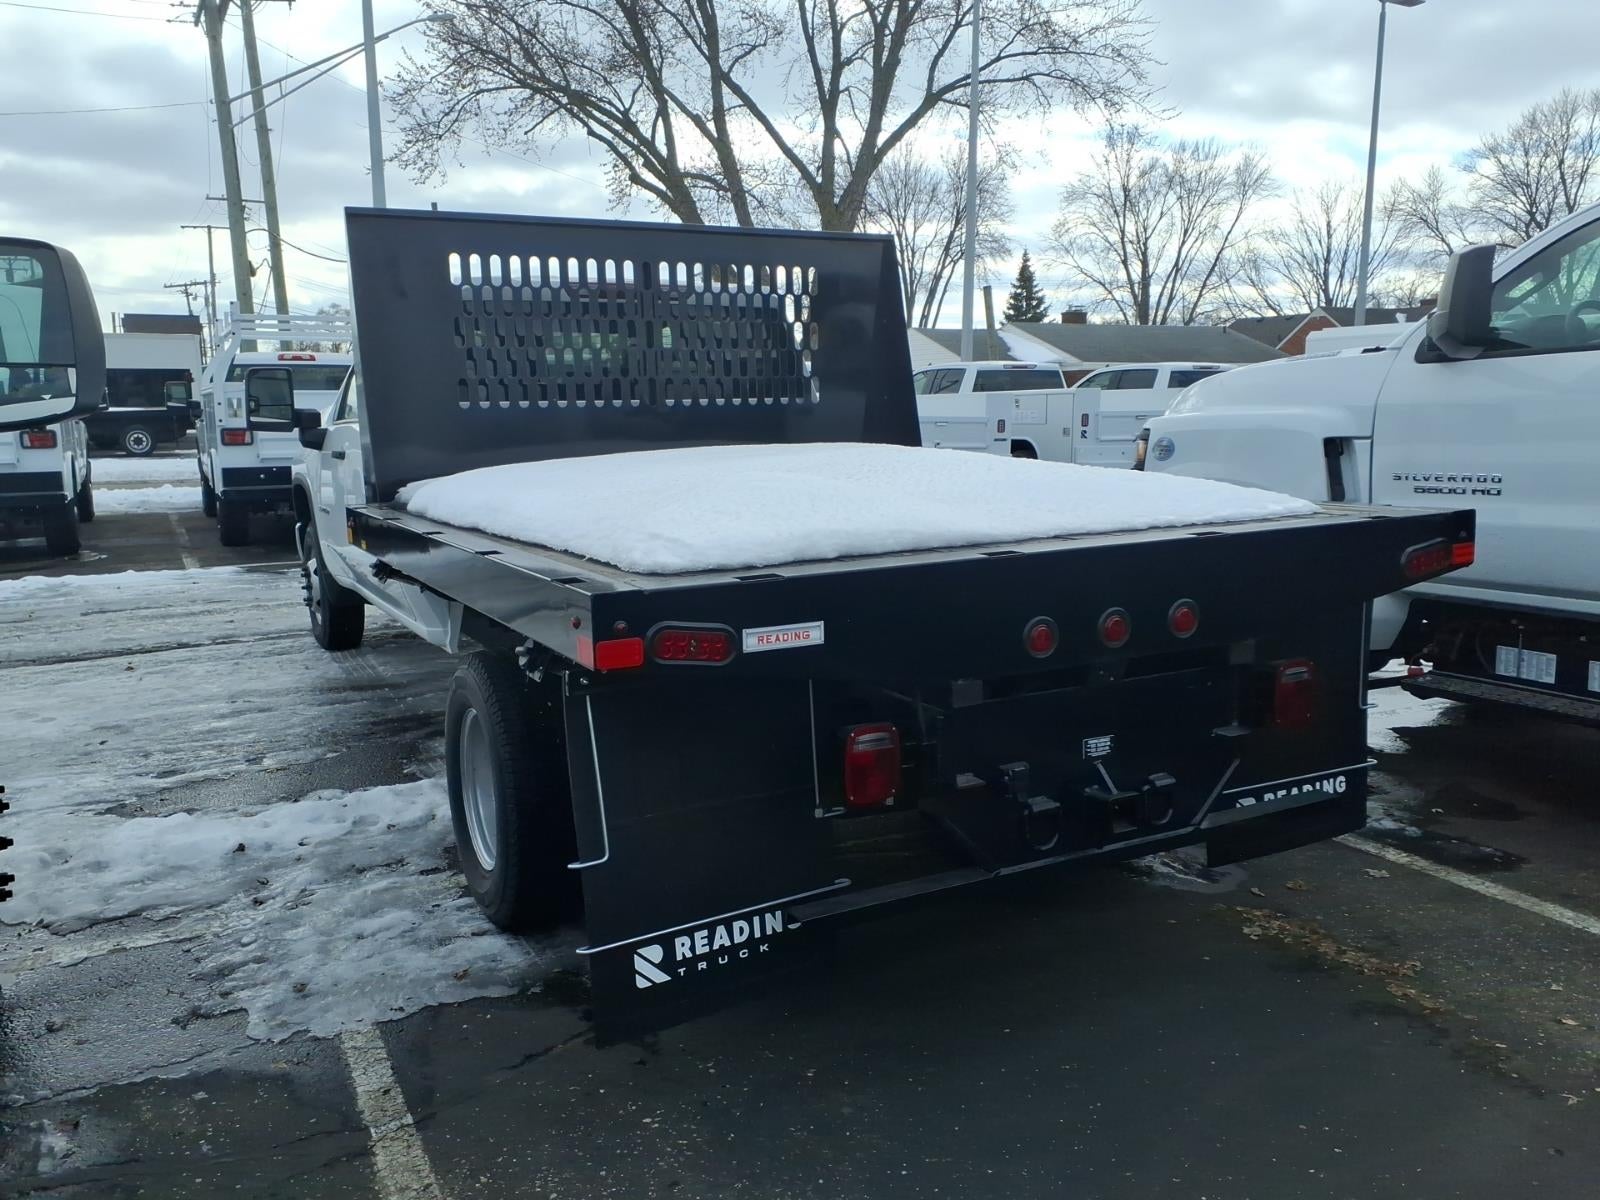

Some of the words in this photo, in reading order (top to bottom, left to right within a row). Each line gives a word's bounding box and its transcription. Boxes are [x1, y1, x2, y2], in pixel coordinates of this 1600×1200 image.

[1391, 472, 1502, 484] SILVERADO
[1471, 487, 1502, 497] HD
[757, 630, 811, 645] READING
[674, 910, 801, 961] READIN
[677, 943, 770, 976] TRUCK
